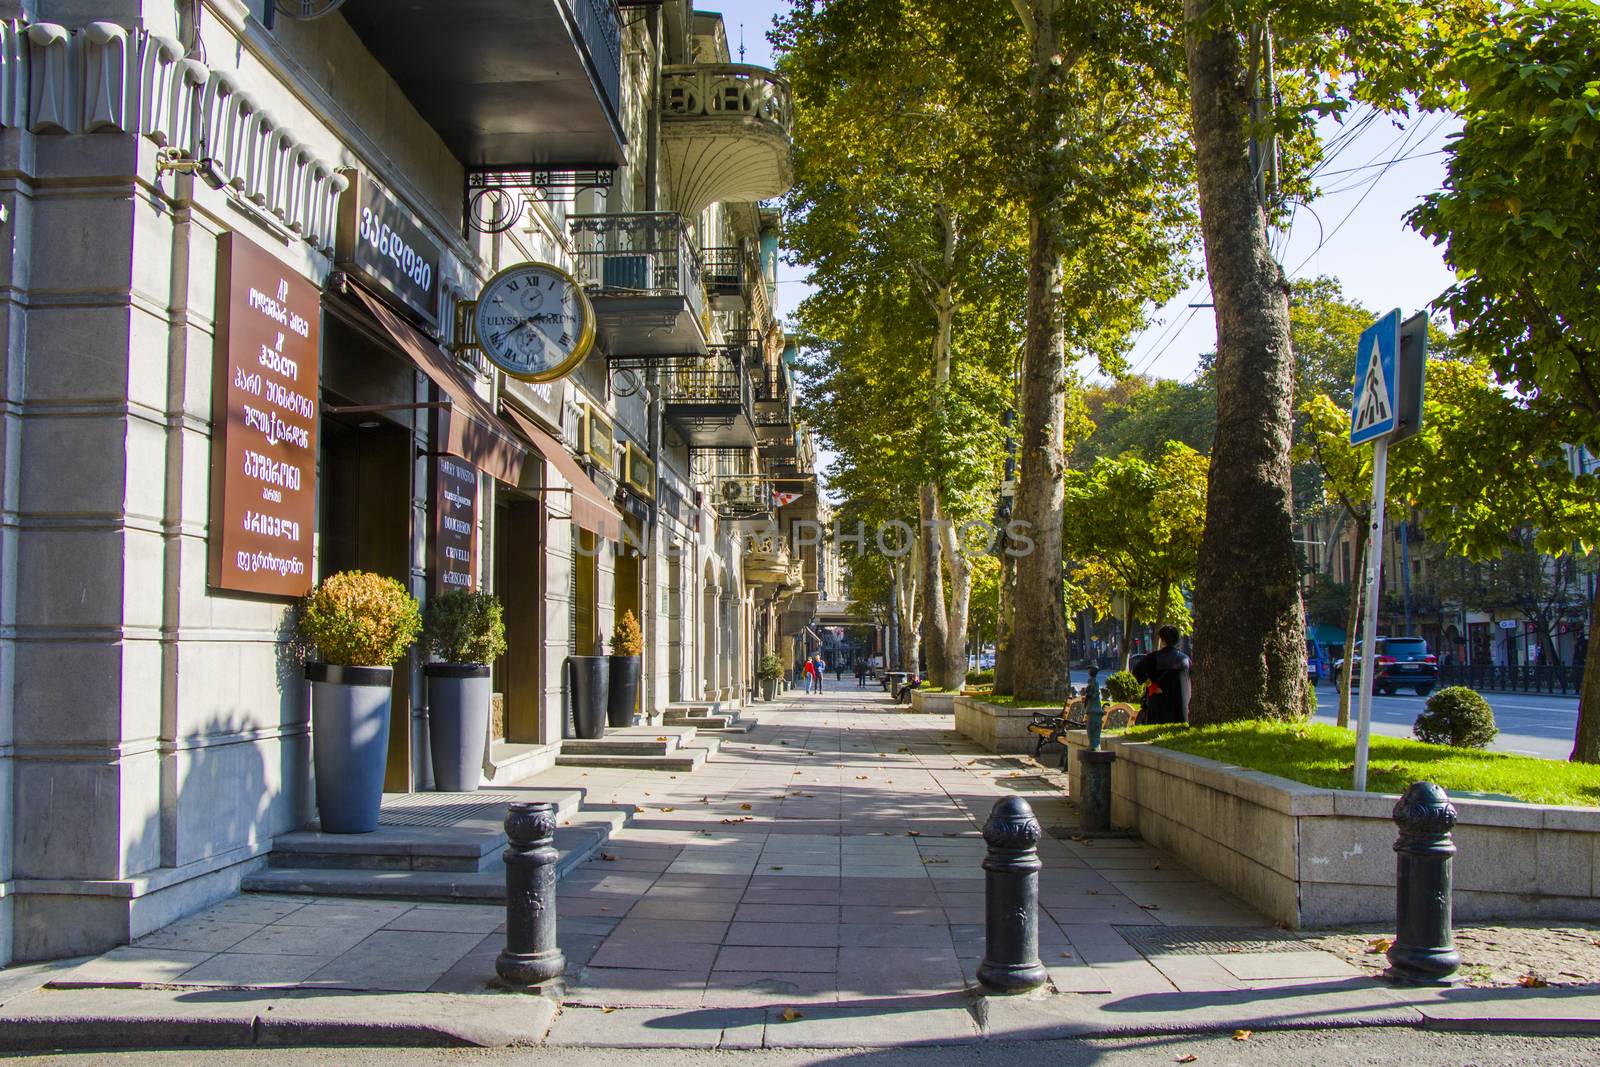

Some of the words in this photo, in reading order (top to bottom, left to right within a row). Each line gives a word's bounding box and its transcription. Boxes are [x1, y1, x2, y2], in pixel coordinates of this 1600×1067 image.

[360, 207, 431, 292] ვანდომი
[247, 287, 287, 326] ოდემარ
[259, 344, 297, 381] ჰუბლო
[235, 365, 261, 396] ჰარი
[243, 510, 299, 541] კრიველი
[237, 551, 250, 571] დე
